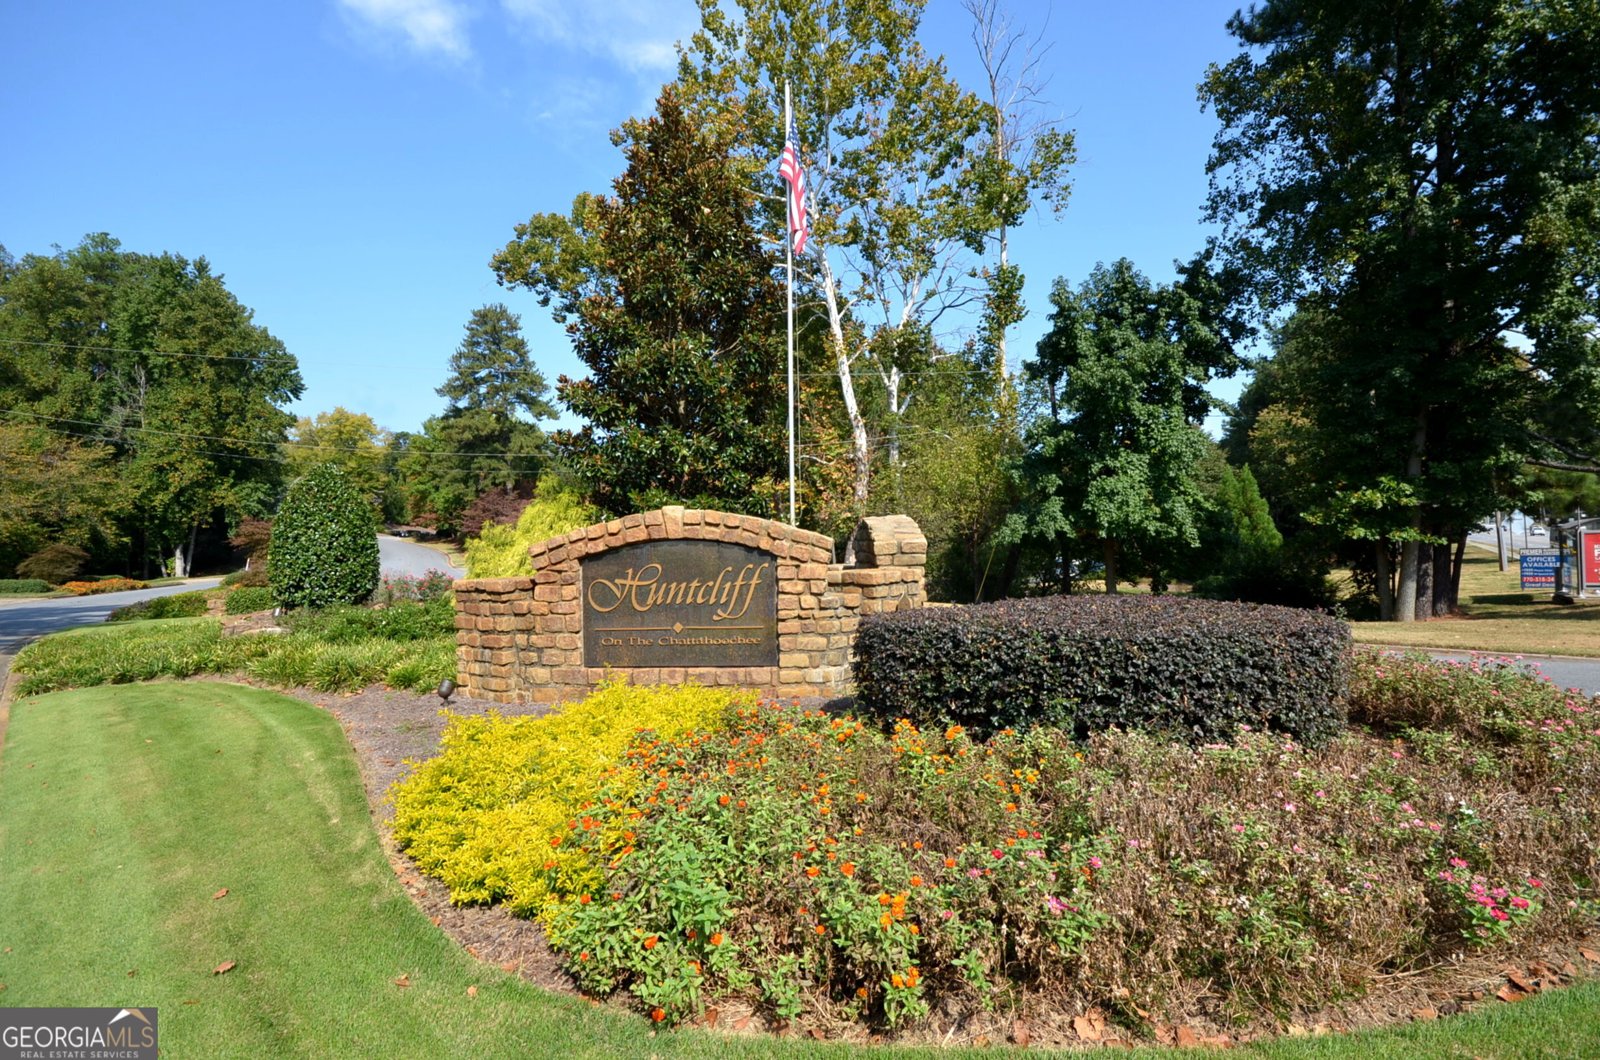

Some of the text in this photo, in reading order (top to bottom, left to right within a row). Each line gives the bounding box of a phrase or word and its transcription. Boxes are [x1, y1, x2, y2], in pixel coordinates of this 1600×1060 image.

[588, 563, 769, 621] Huntcliff
[601, 635, 761, 646] On The Chattahoochee
